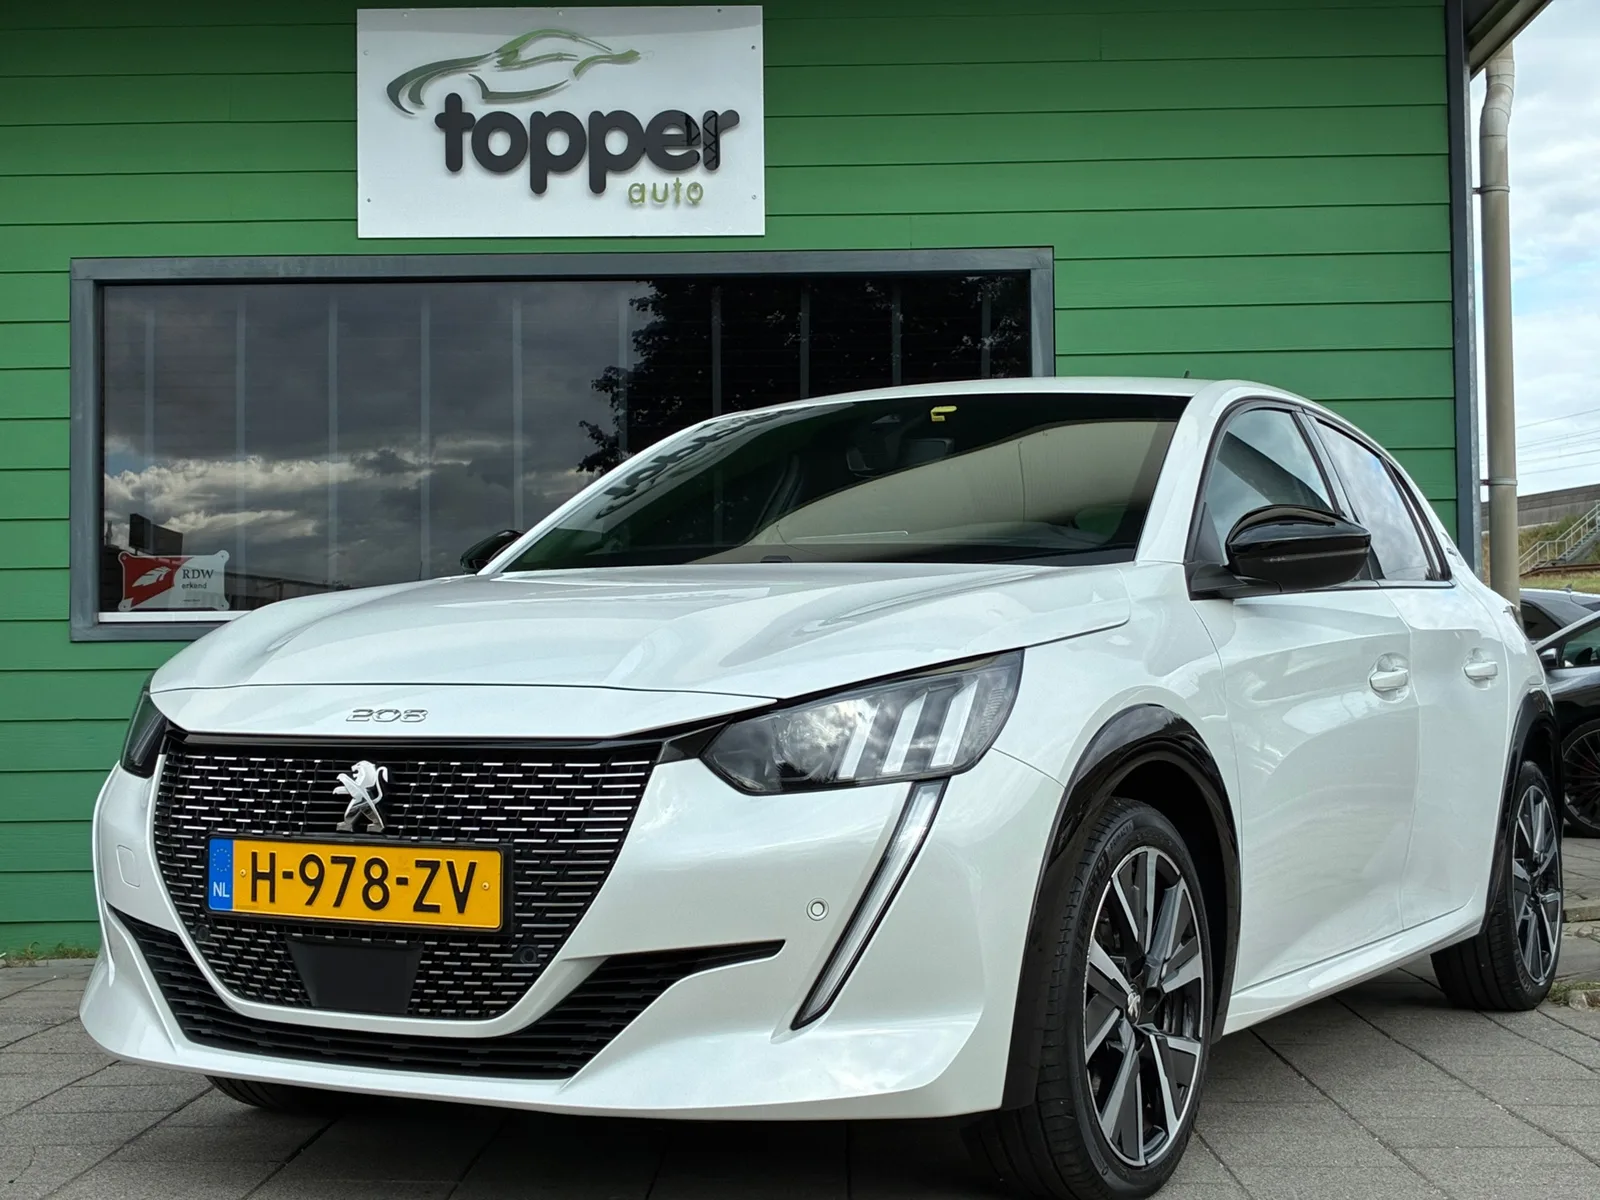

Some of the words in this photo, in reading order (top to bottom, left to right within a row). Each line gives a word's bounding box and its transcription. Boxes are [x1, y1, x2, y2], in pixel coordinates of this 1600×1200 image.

[434, 92, 740, 195] topper
[627, 178, 704, 206] auto
[182, 569, 214, 579] RDW
[346, 708, 428, 722] 208
[212, 881, 230, 897] NL
[250, 851, 477, 914] H-978-ZV
